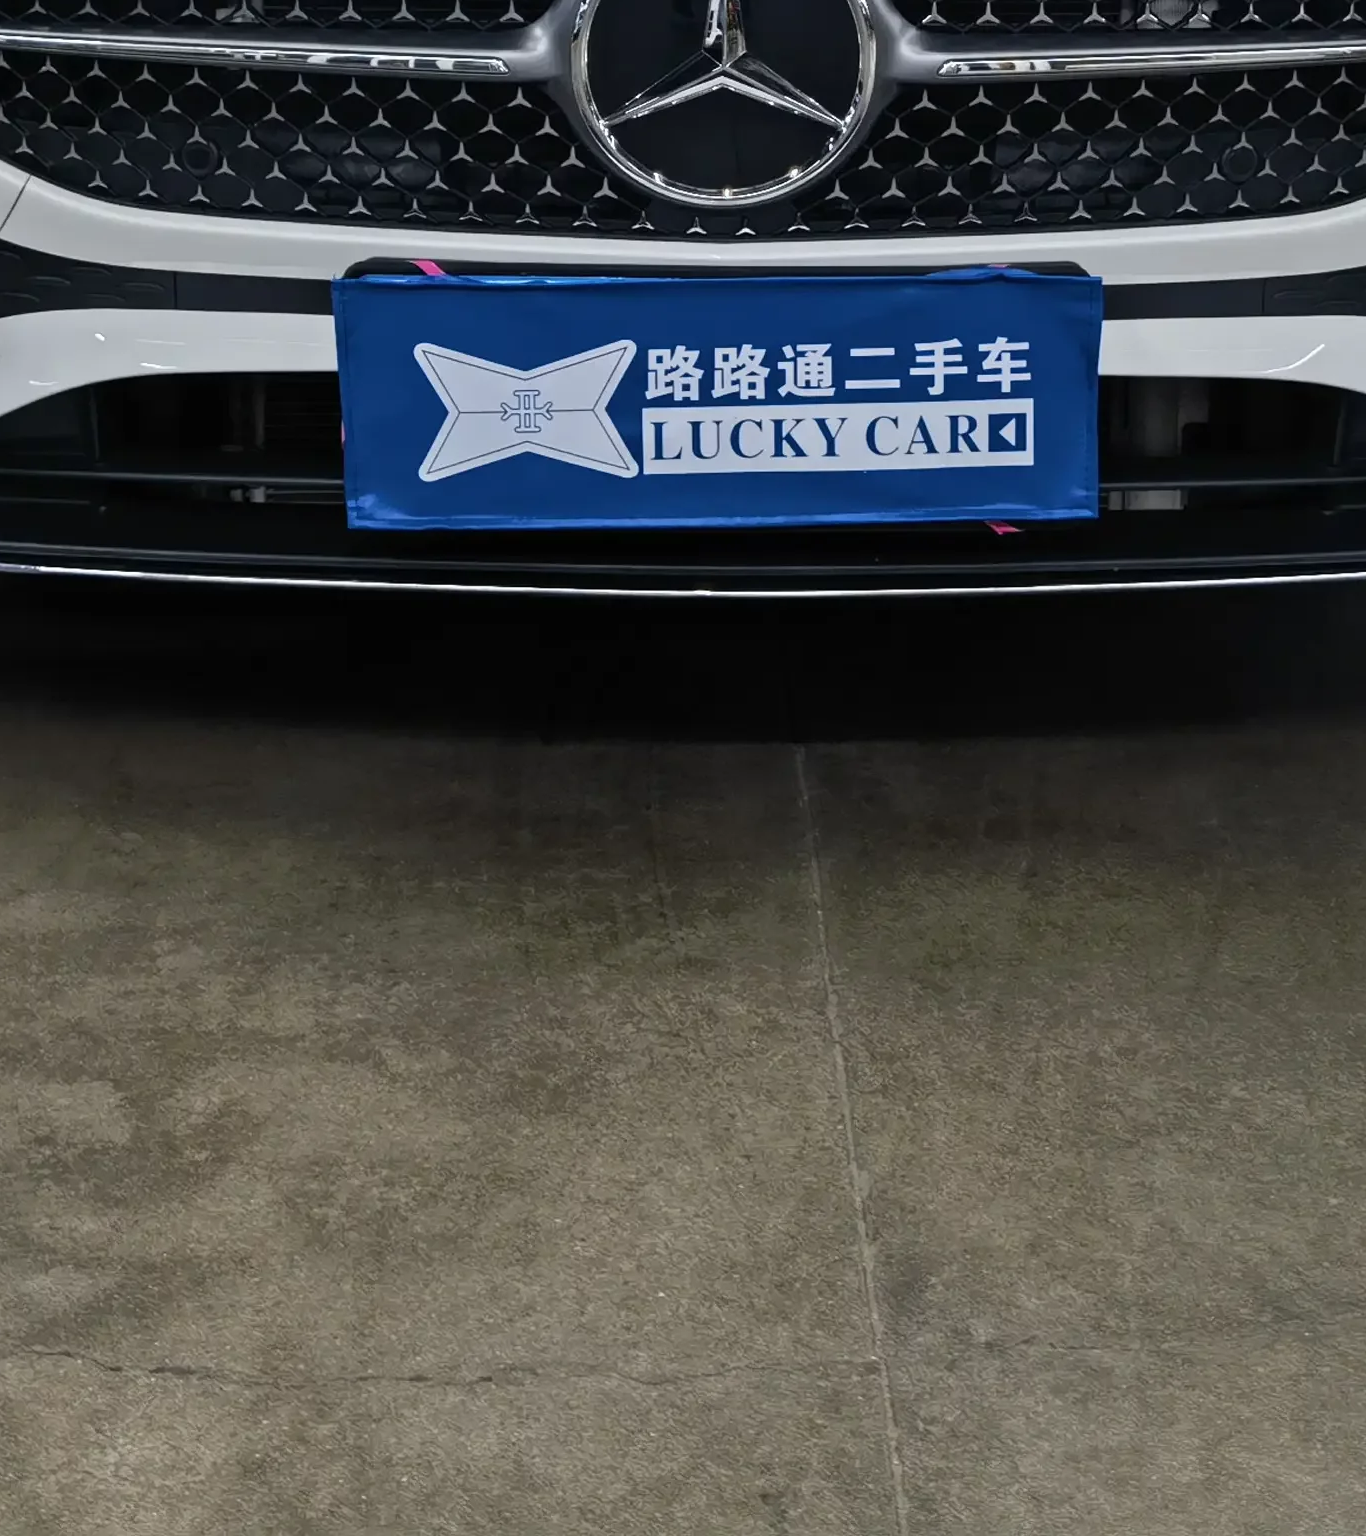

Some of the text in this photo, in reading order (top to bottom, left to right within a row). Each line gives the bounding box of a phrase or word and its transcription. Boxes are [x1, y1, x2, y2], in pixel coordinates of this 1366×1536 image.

[644, 336, 1032, 402] 路路通二手车
[649, 414, 982, 461] LUCKY CAR
